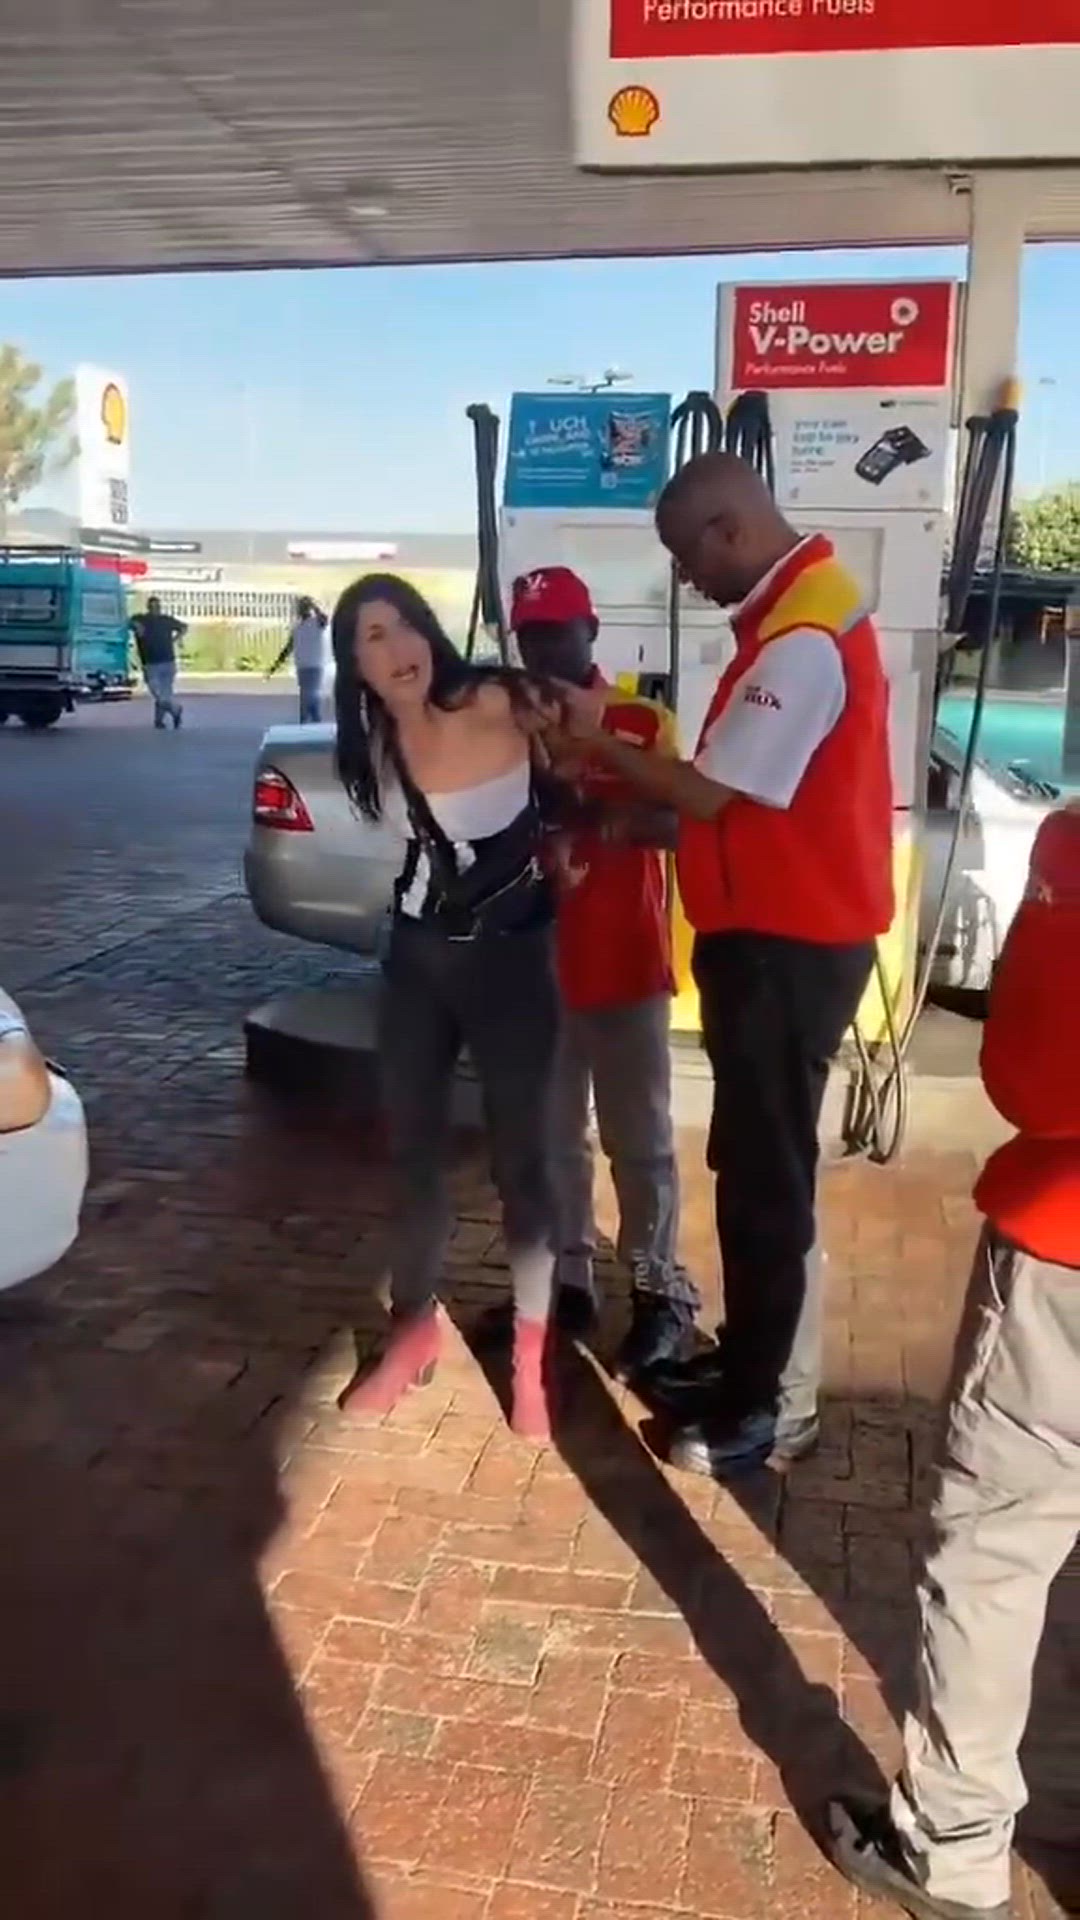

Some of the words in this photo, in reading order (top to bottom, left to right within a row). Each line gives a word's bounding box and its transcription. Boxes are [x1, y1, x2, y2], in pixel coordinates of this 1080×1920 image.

[643, 0, 802, 23] Performance
[812, 0, 876, 15] Fuels
[749, 301, 806, 323] Shell
[749, 325, 903, 355] V-Power
